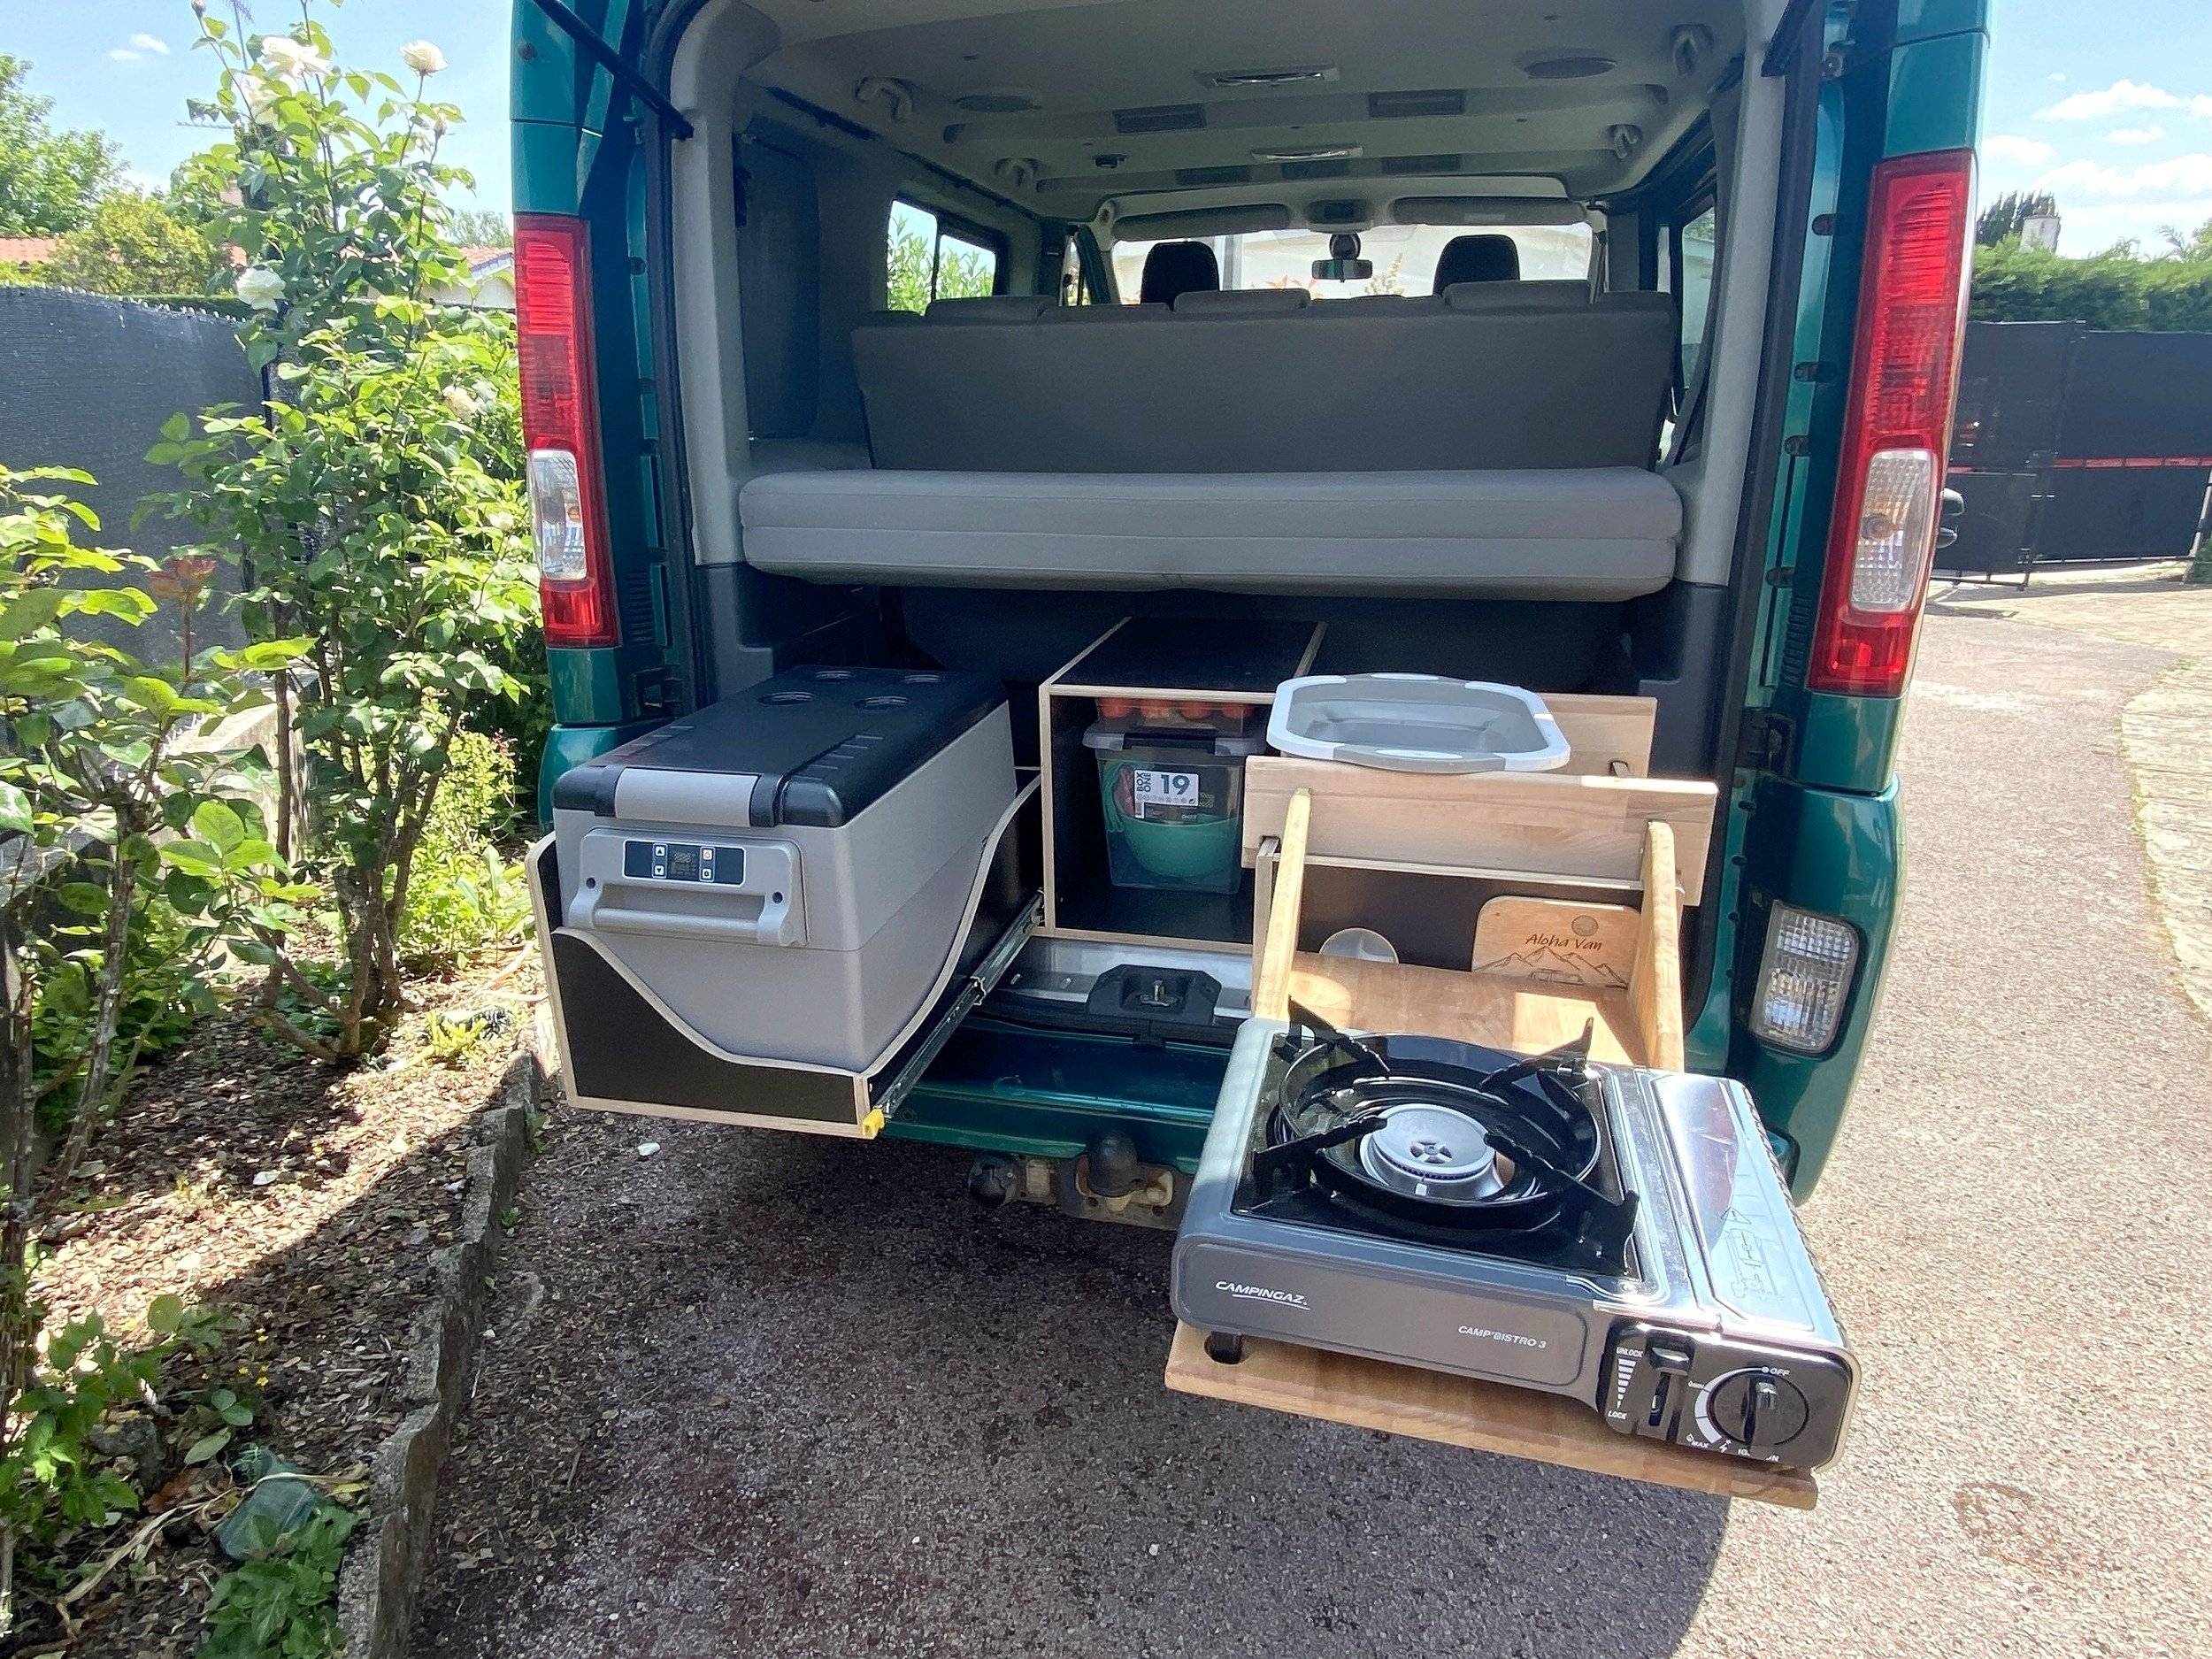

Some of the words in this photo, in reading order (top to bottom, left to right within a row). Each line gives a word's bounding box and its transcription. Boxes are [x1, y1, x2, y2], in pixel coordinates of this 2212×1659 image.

[1161, 774, 1190, 795] 19
[1525, 933, 1569, 948] Aloha
[1574, 938, 1602, 951] Van
[1215, 1280, 1306, 1304] CAMPINGAZ
[1616, 1346, 1644, 1358] UNLOCK
[1770, 1367, 1790, 1376] OFF
[1608, 1410, 1627, 1420] LOCK
